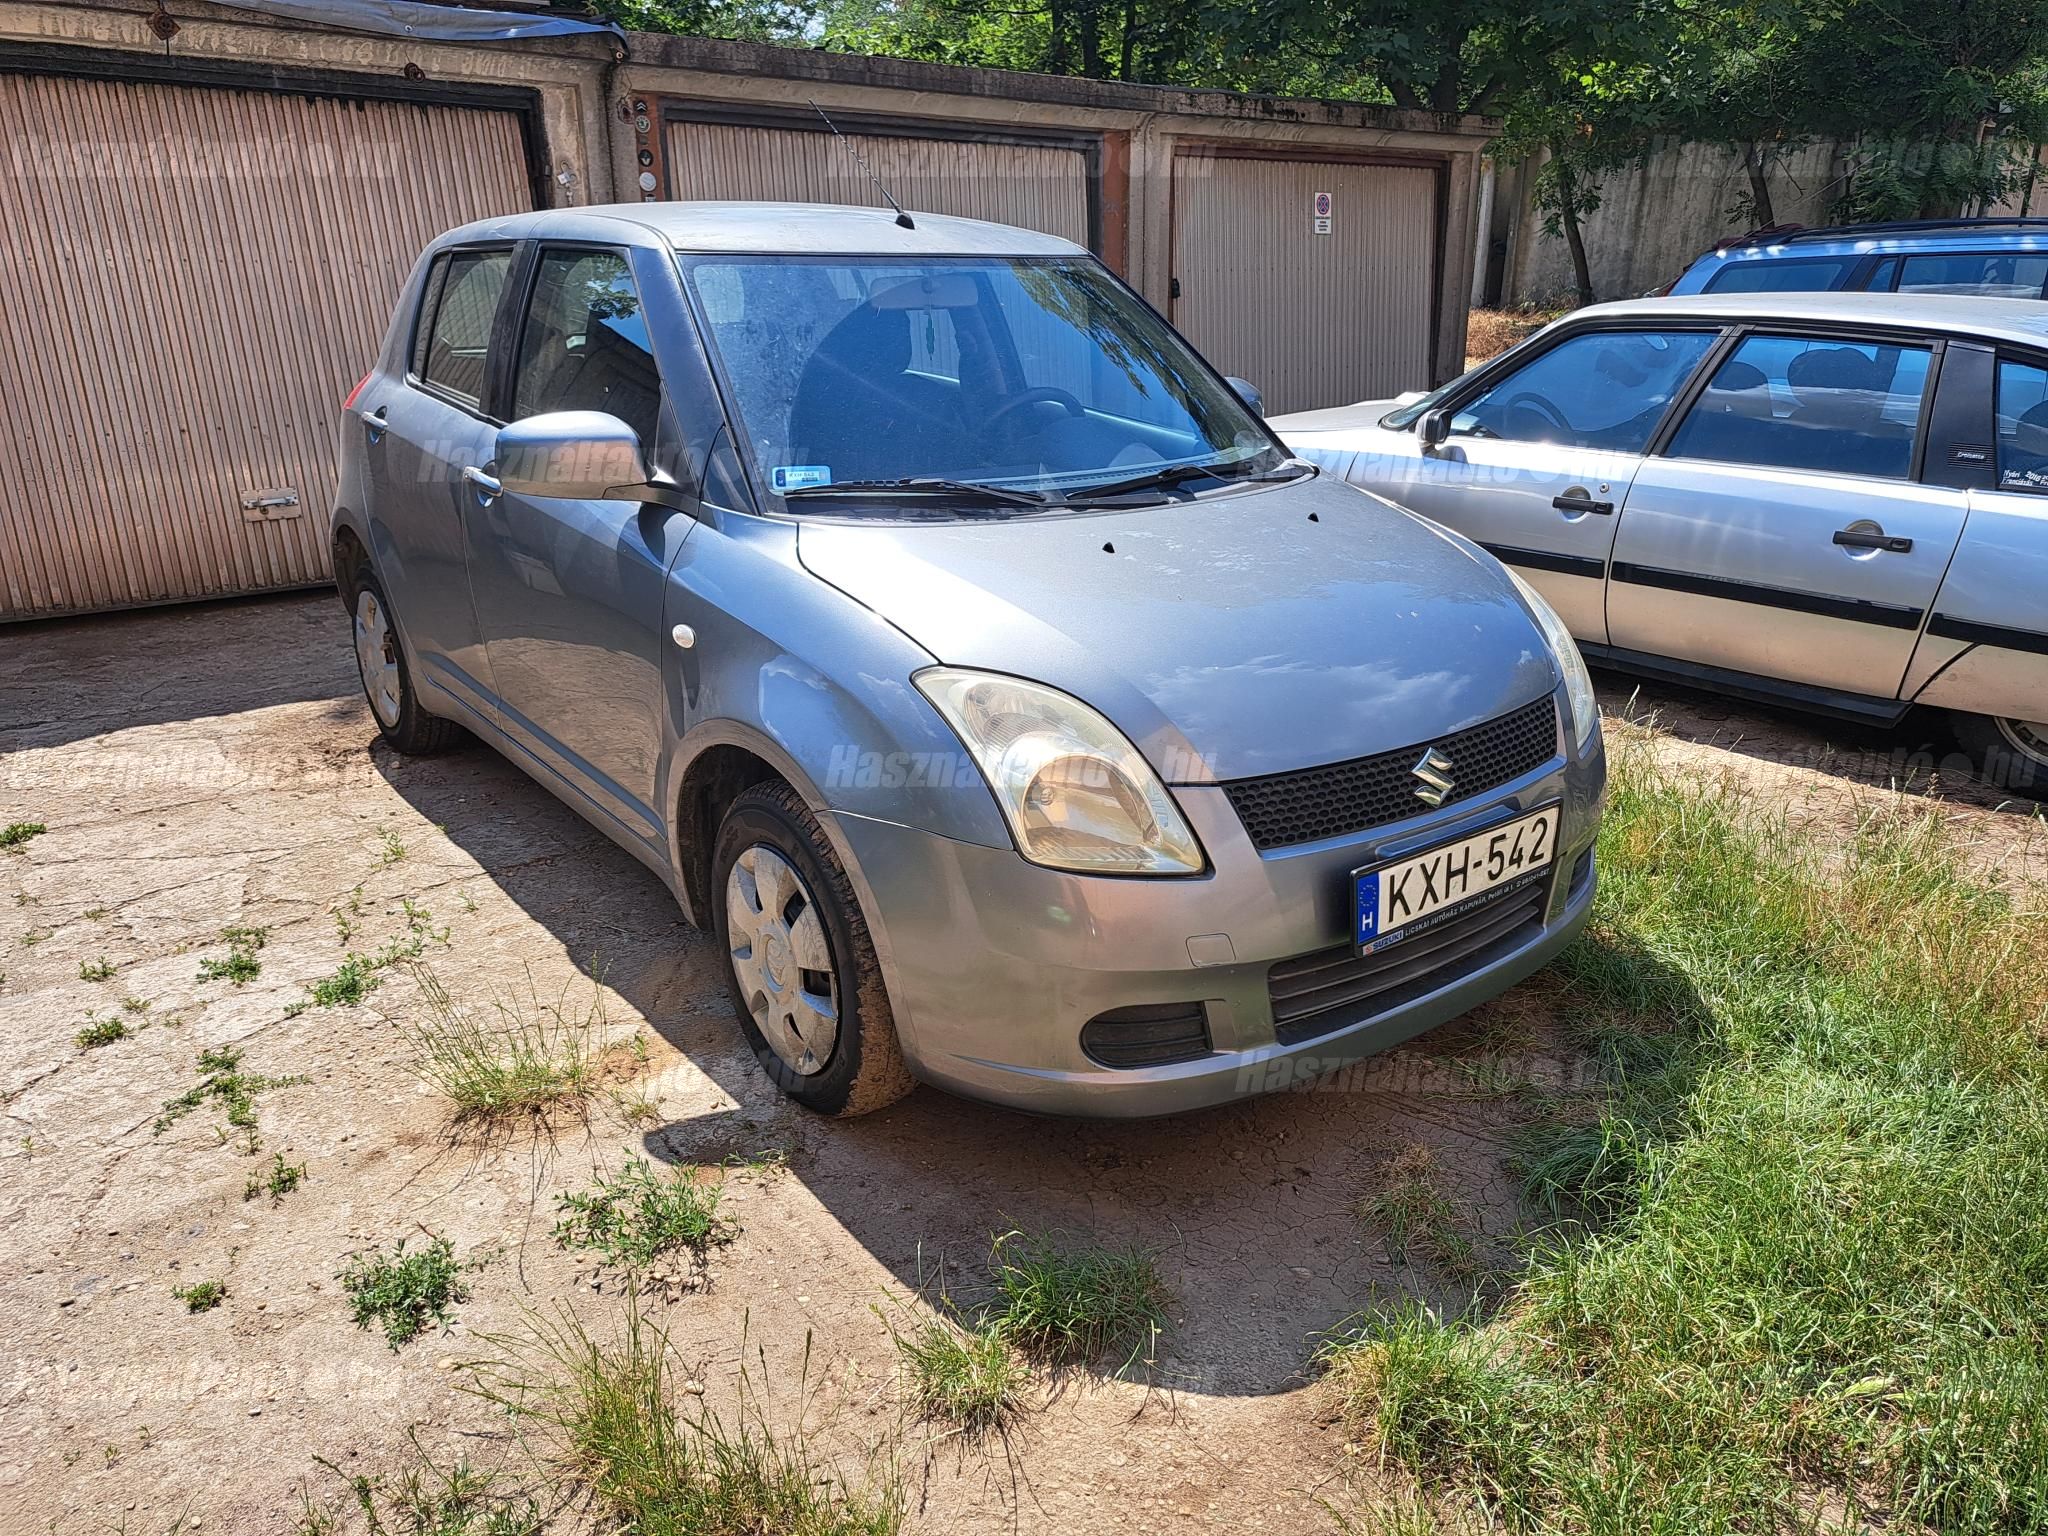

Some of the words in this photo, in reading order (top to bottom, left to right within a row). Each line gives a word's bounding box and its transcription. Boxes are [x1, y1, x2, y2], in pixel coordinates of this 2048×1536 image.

[1387, 816, 1549, 923] KXH-542
[1361, 911, 1374, 932] H
[1373, 930, 1403, 951] SUZUKI
